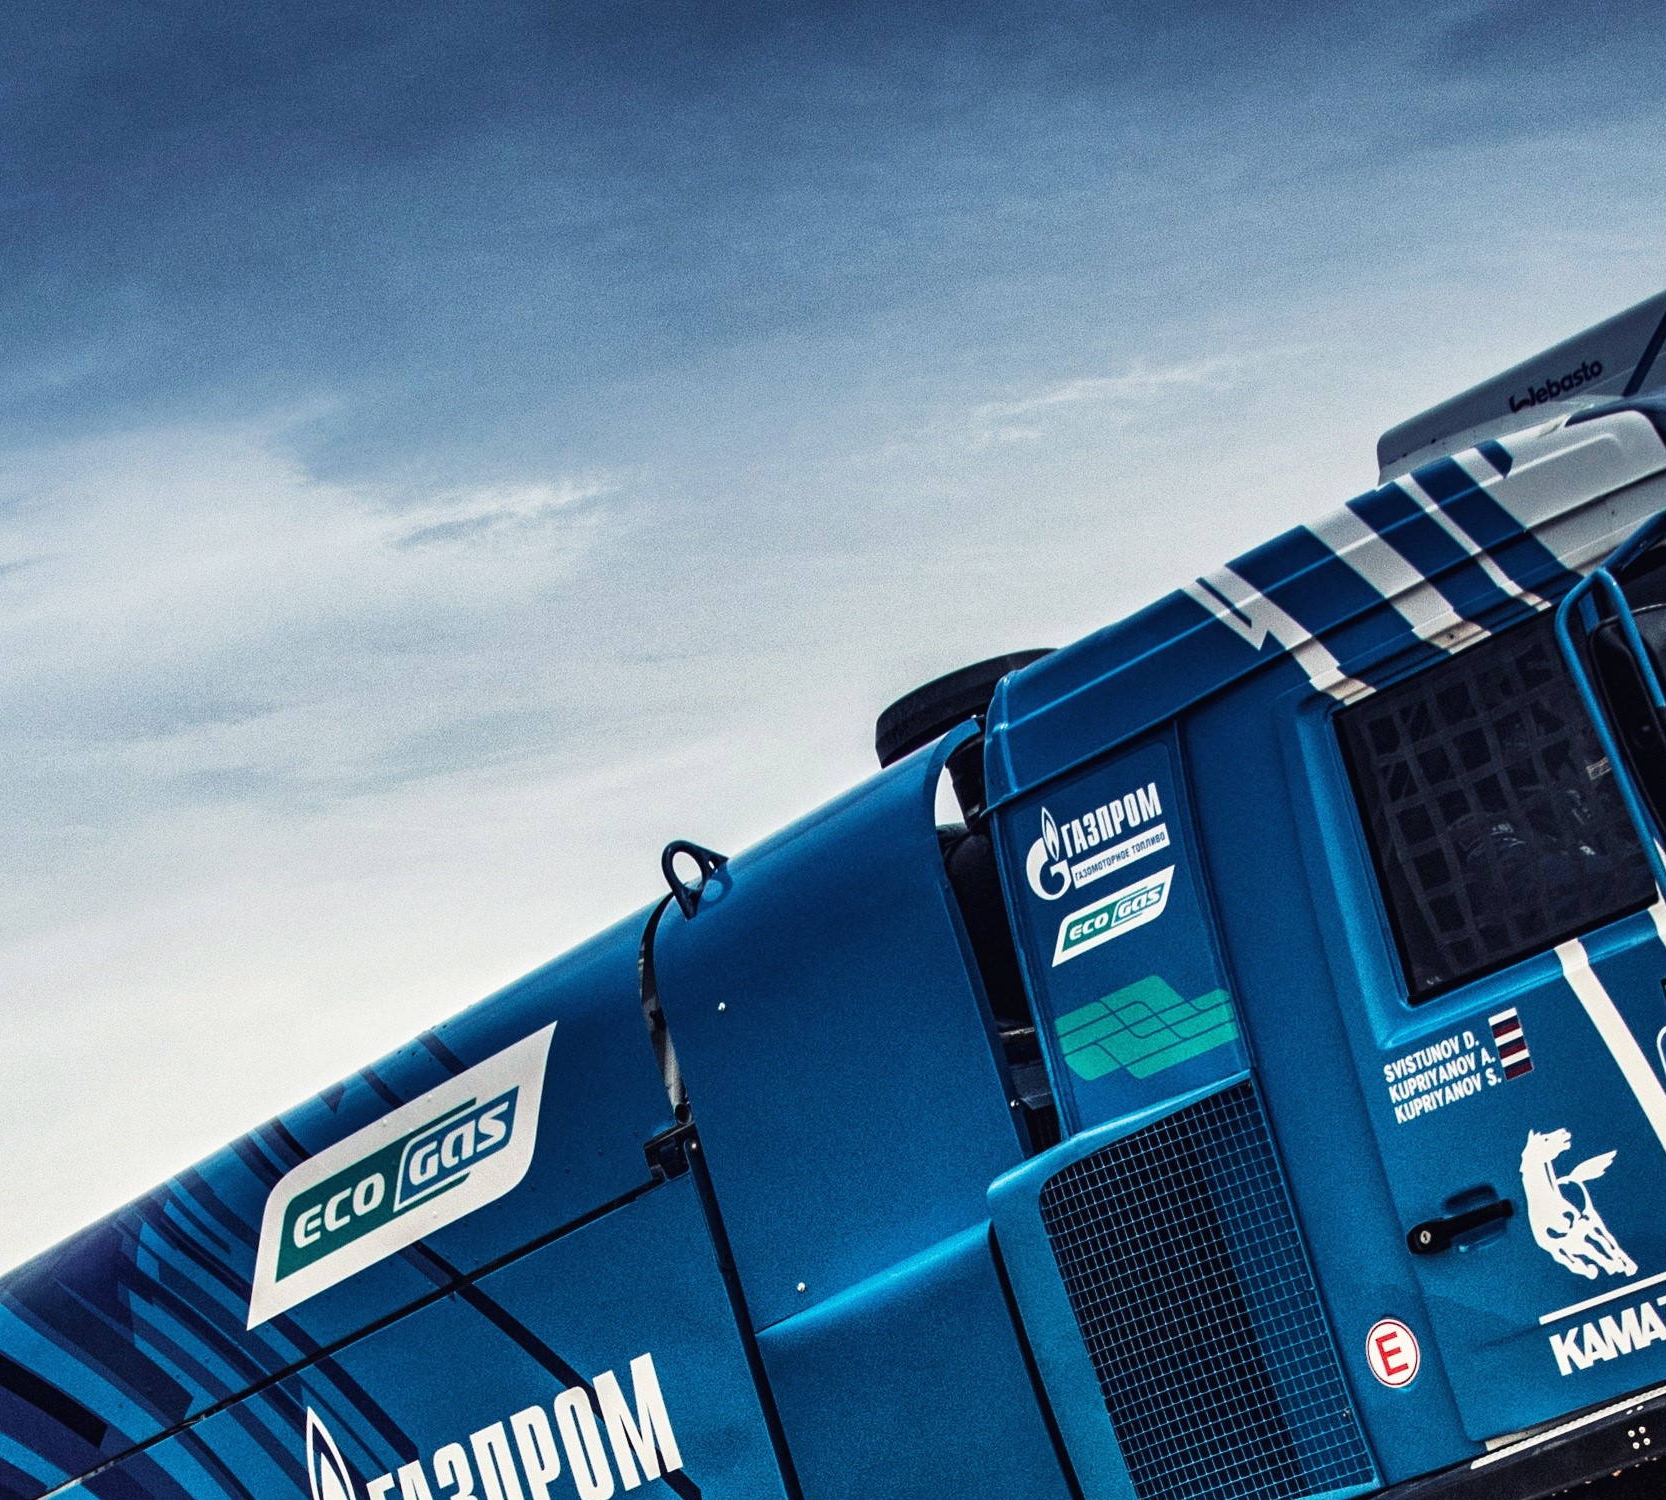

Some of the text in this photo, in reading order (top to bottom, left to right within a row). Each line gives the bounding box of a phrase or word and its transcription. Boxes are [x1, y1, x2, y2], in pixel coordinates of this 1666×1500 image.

[1060, 782, 1163, 858] ГАЗПРОМ
[1074, 831, 1167, 881] ГАЗОМОТОРНОЕ ТОПЛИВО
[1069, 912, 1109, 940] ECO
[1383, 1030, 1480, 1083] SVISTUNOV D.
[1388, 1047, 1496, 1104] KUPRIYANOV A.
[1394, 1067, 1503, 1125] KUPRIYANOV S.
[292, 1173, 386, 1248] ECO
[1379, 1329, 1410, 1377] E
